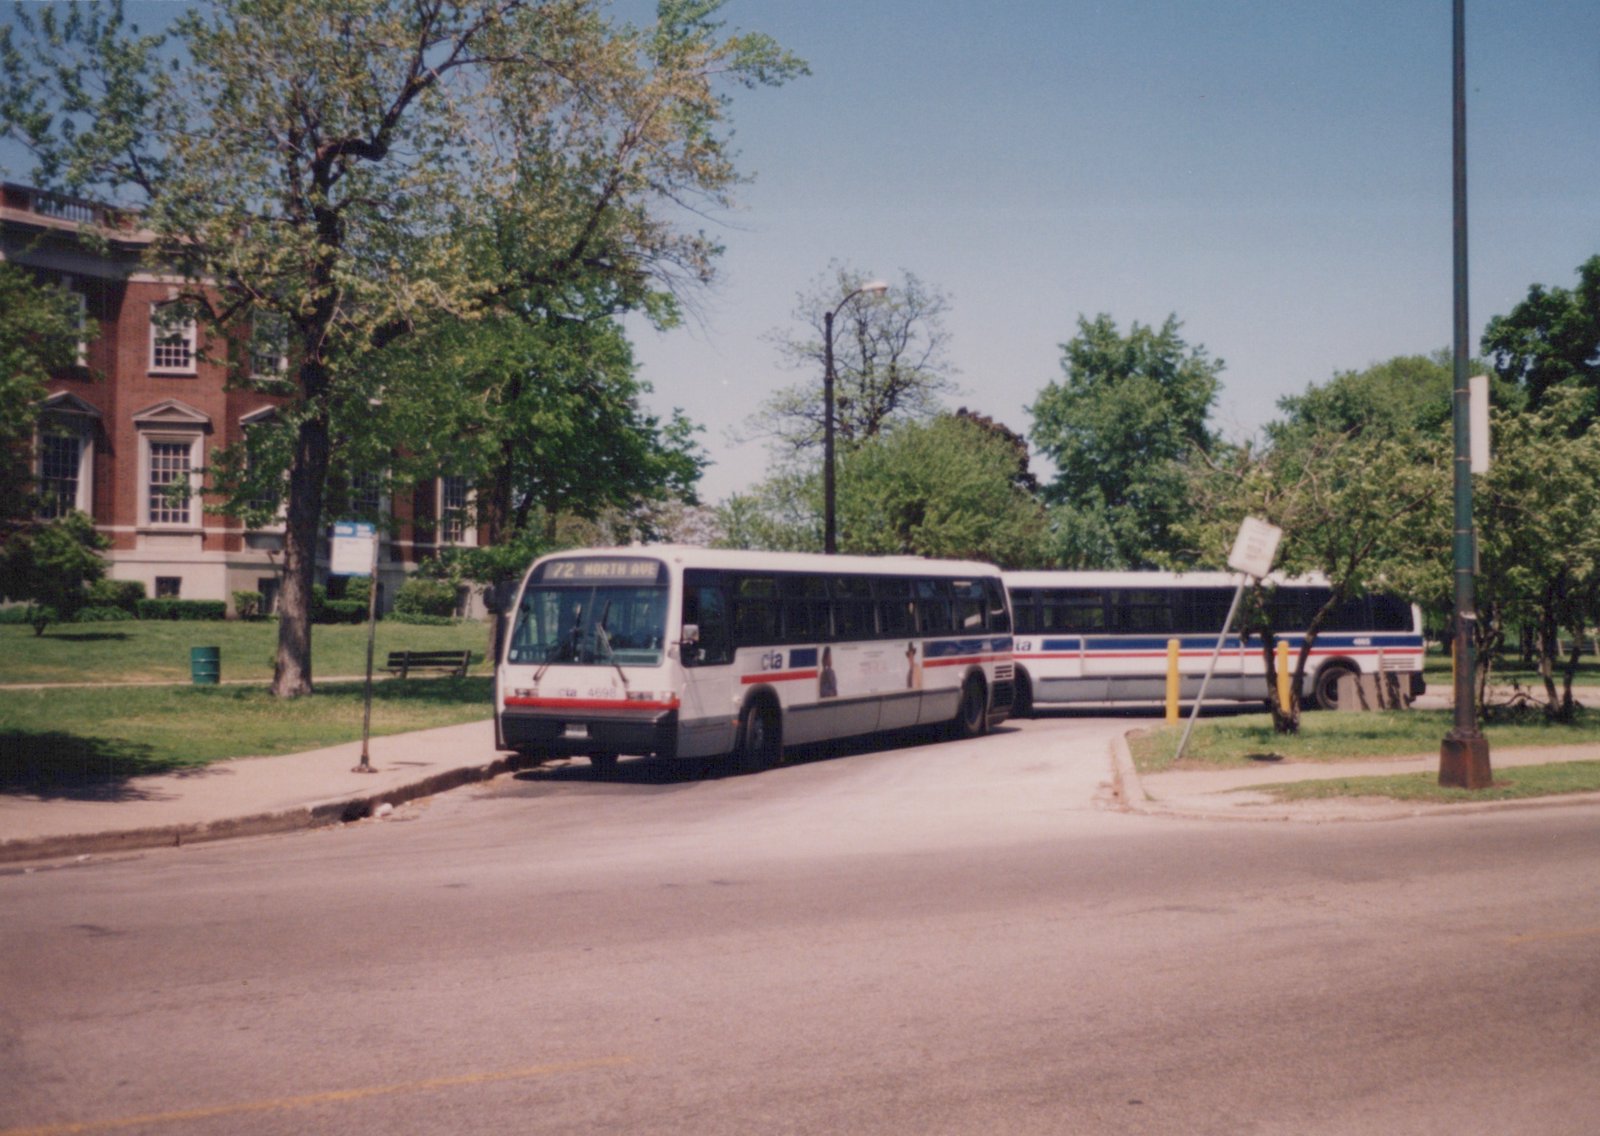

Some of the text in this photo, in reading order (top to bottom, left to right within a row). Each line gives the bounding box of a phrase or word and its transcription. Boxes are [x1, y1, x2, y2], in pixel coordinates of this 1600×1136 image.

[553, 562, 656, 578] 72 NORTH AVE
[760, 649, 783, 671] cta
